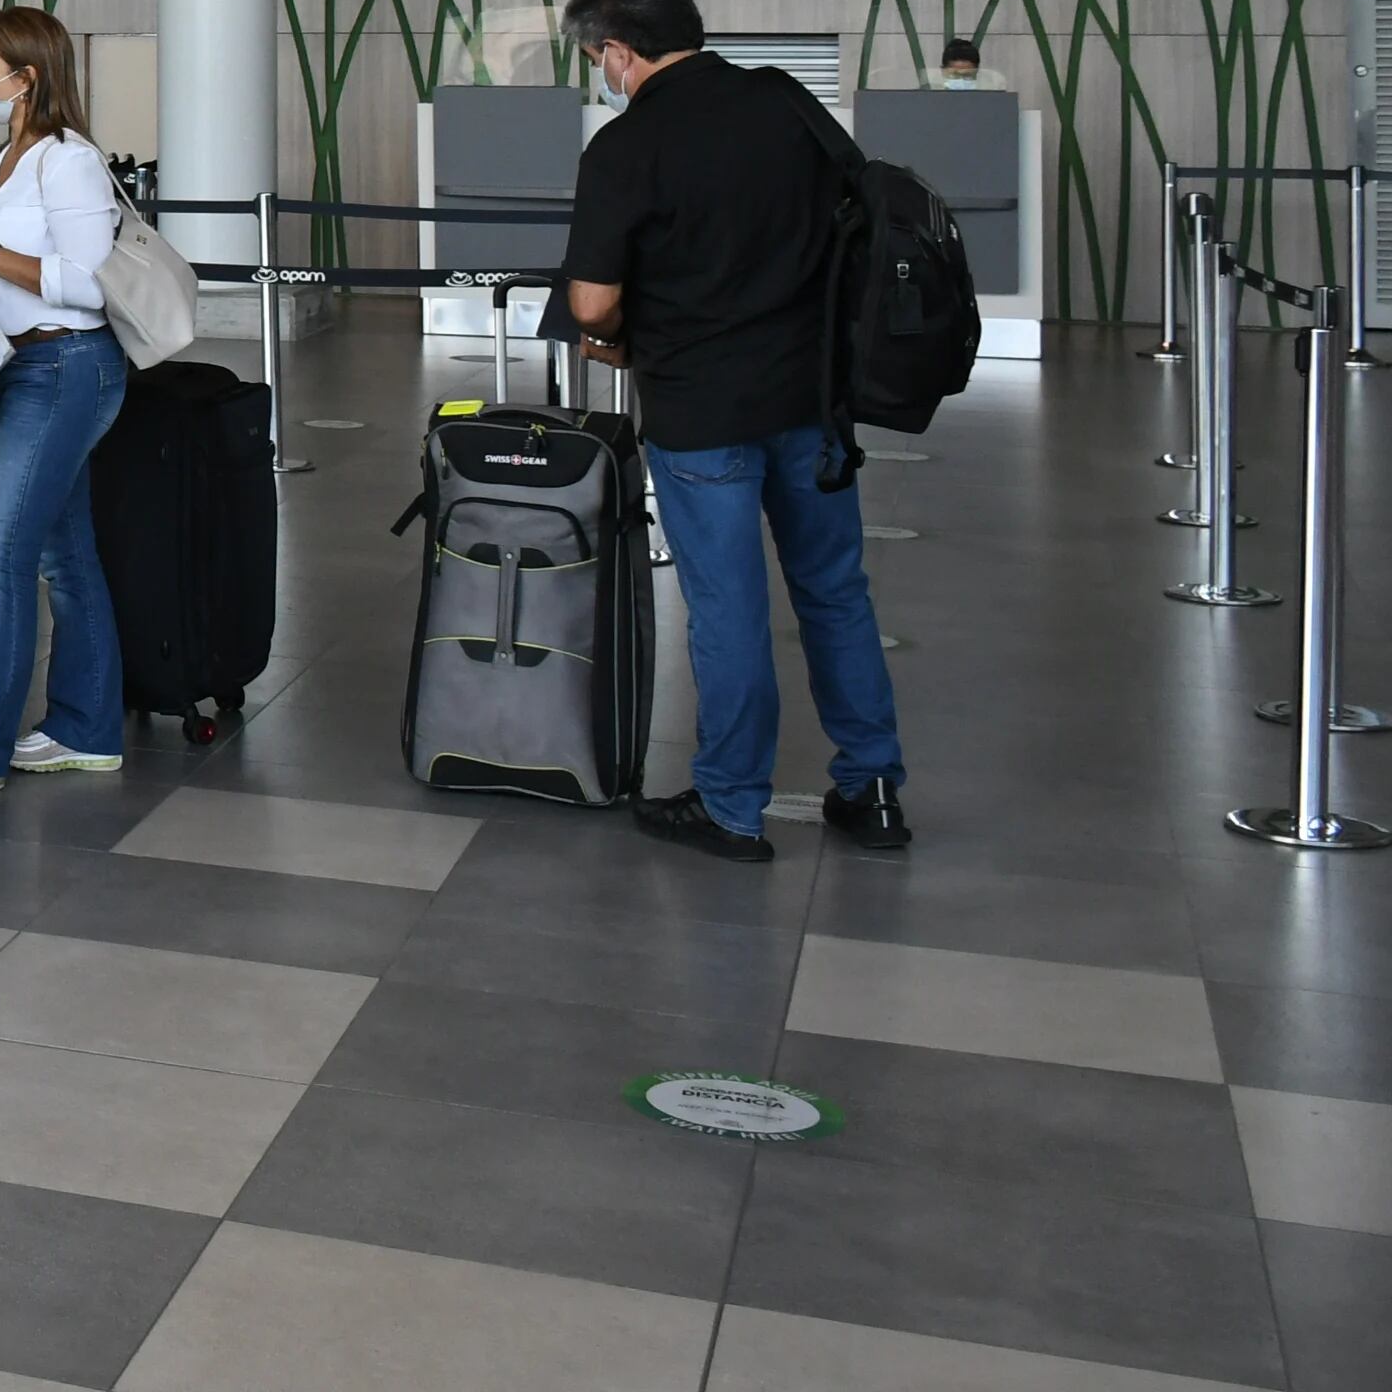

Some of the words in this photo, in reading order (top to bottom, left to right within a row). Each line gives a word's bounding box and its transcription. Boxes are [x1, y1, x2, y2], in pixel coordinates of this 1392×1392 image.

[279, 270, 326, 284] opam
[484, 454, 510, 464] SWISS
[521, 456, 547, 466] GEAR
[682, 1089, 786, 1110] DISTANCIA
